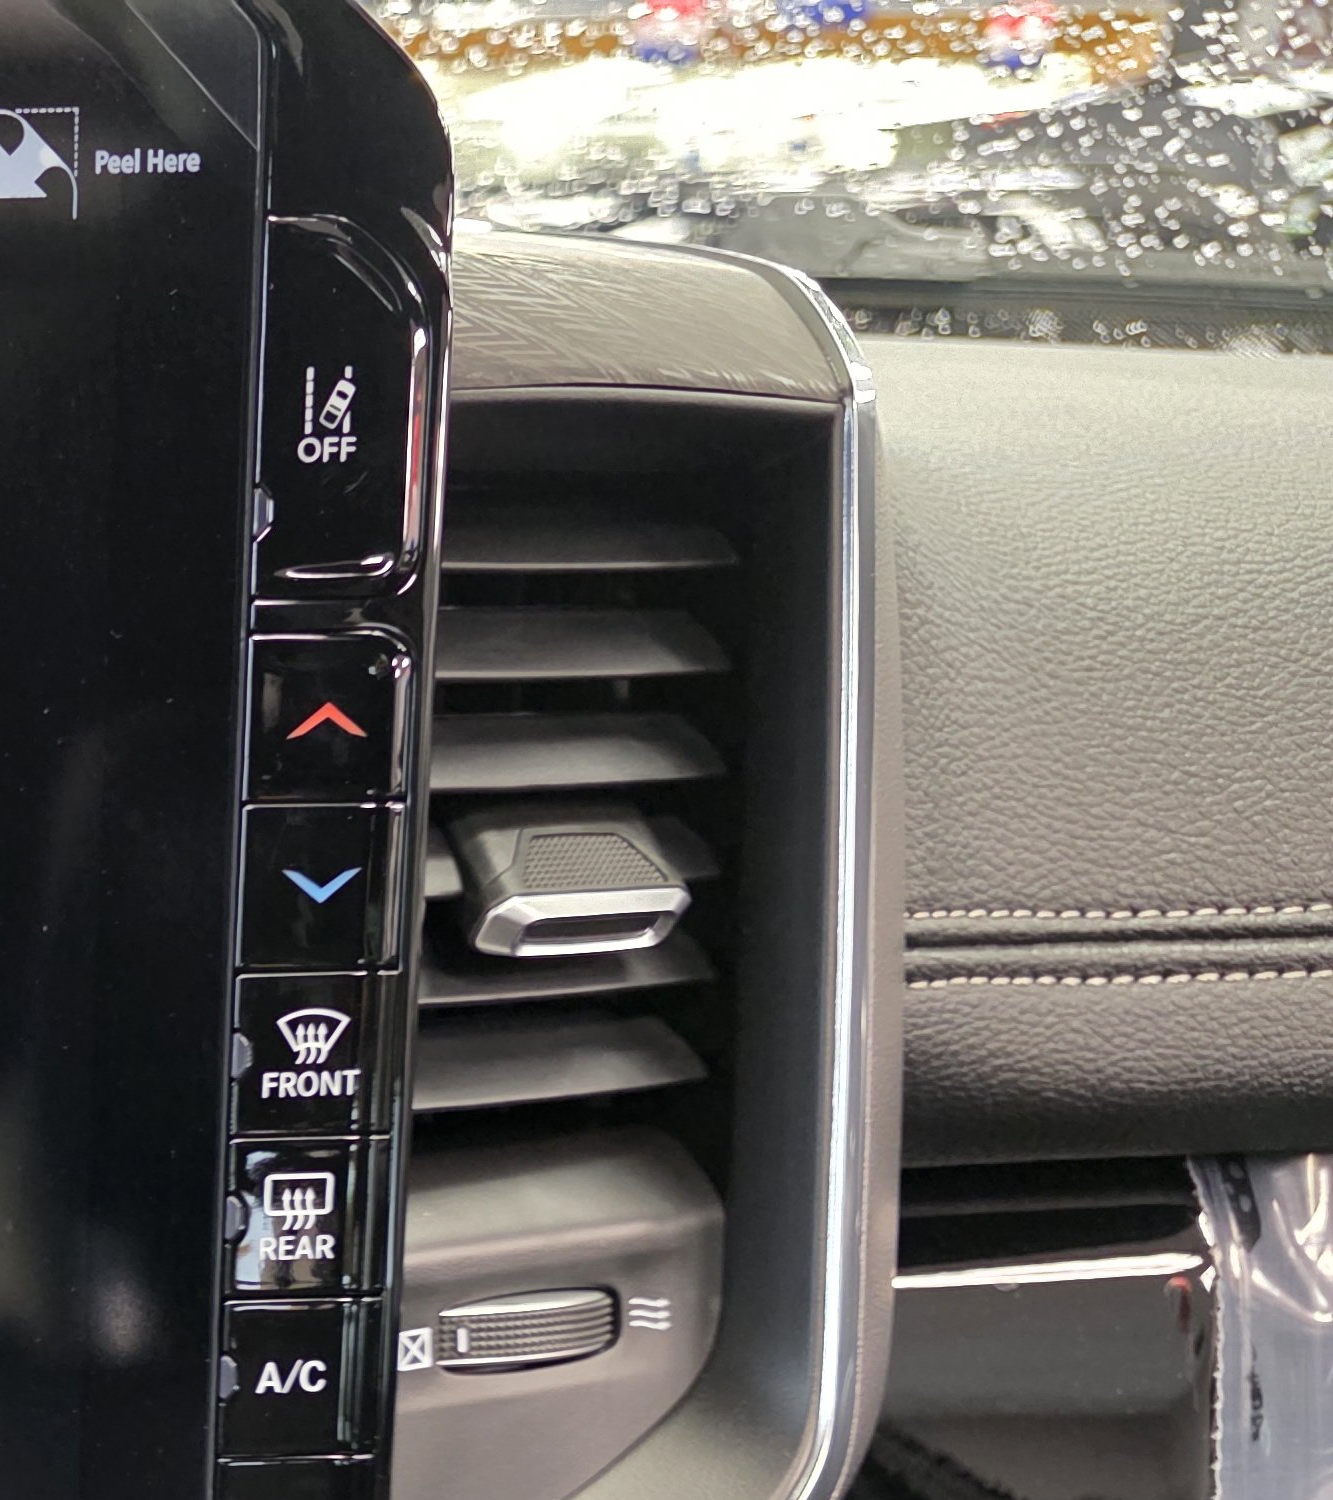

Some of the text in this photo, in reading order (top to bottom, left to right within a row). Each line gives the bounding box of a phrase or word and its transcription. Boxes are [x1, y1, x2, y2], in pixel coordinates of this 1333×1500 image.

[94, 147, 201, 175] Peel Here
[297, 436, 358, 463] OFF
[261, 1068, 362, 1099] FRONT
[258, 1234, 336, 1262] REAR
[254, 1359, 327, 1394] A/C
